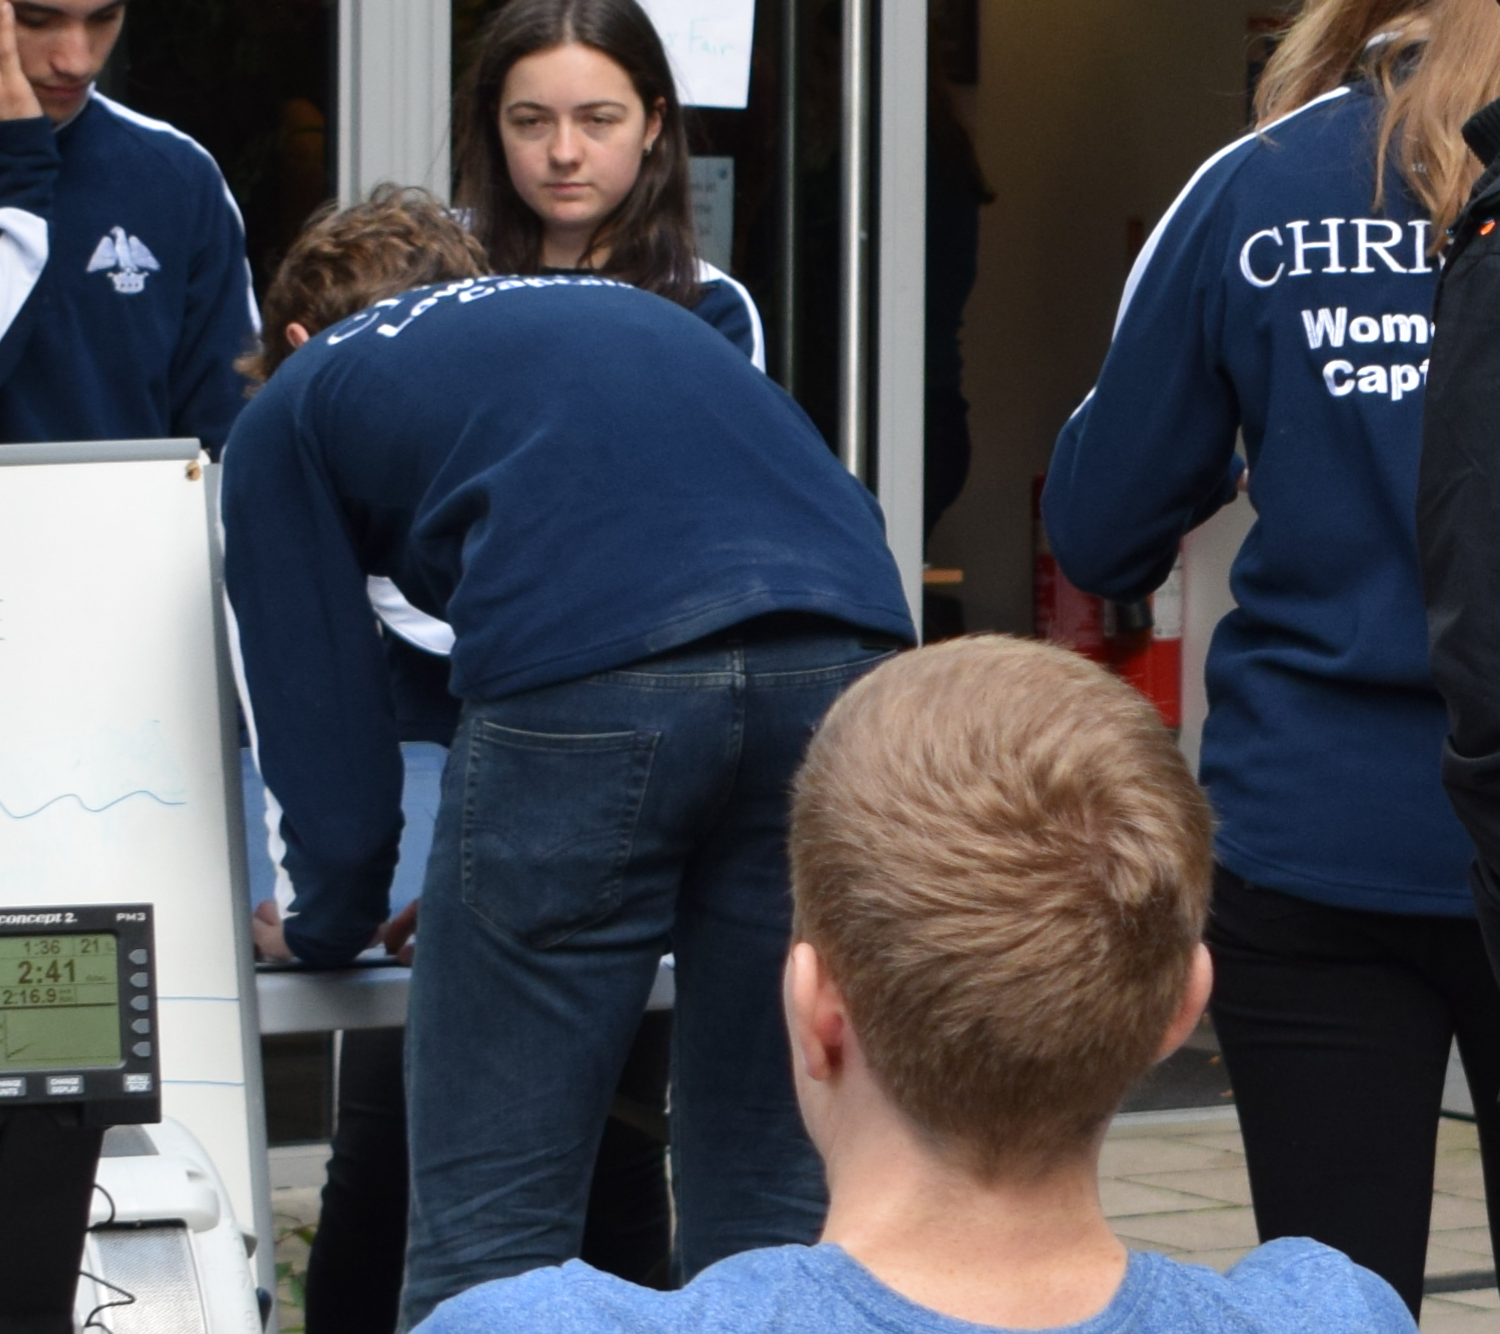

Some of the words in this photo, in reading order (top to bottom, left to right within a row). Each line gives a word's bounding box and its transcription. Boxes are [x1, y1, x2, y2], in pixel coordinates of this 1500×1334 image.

[1240, 218, 1445, 288] CHRI
[1301, 307, 1435, 350] Wom
[116, 912, 146, 922] PM3
[81, 938, 99, 954] 21
[17, 959, 76, 985] 2:41
[2, 988, 57, 1005] 2:16.9
